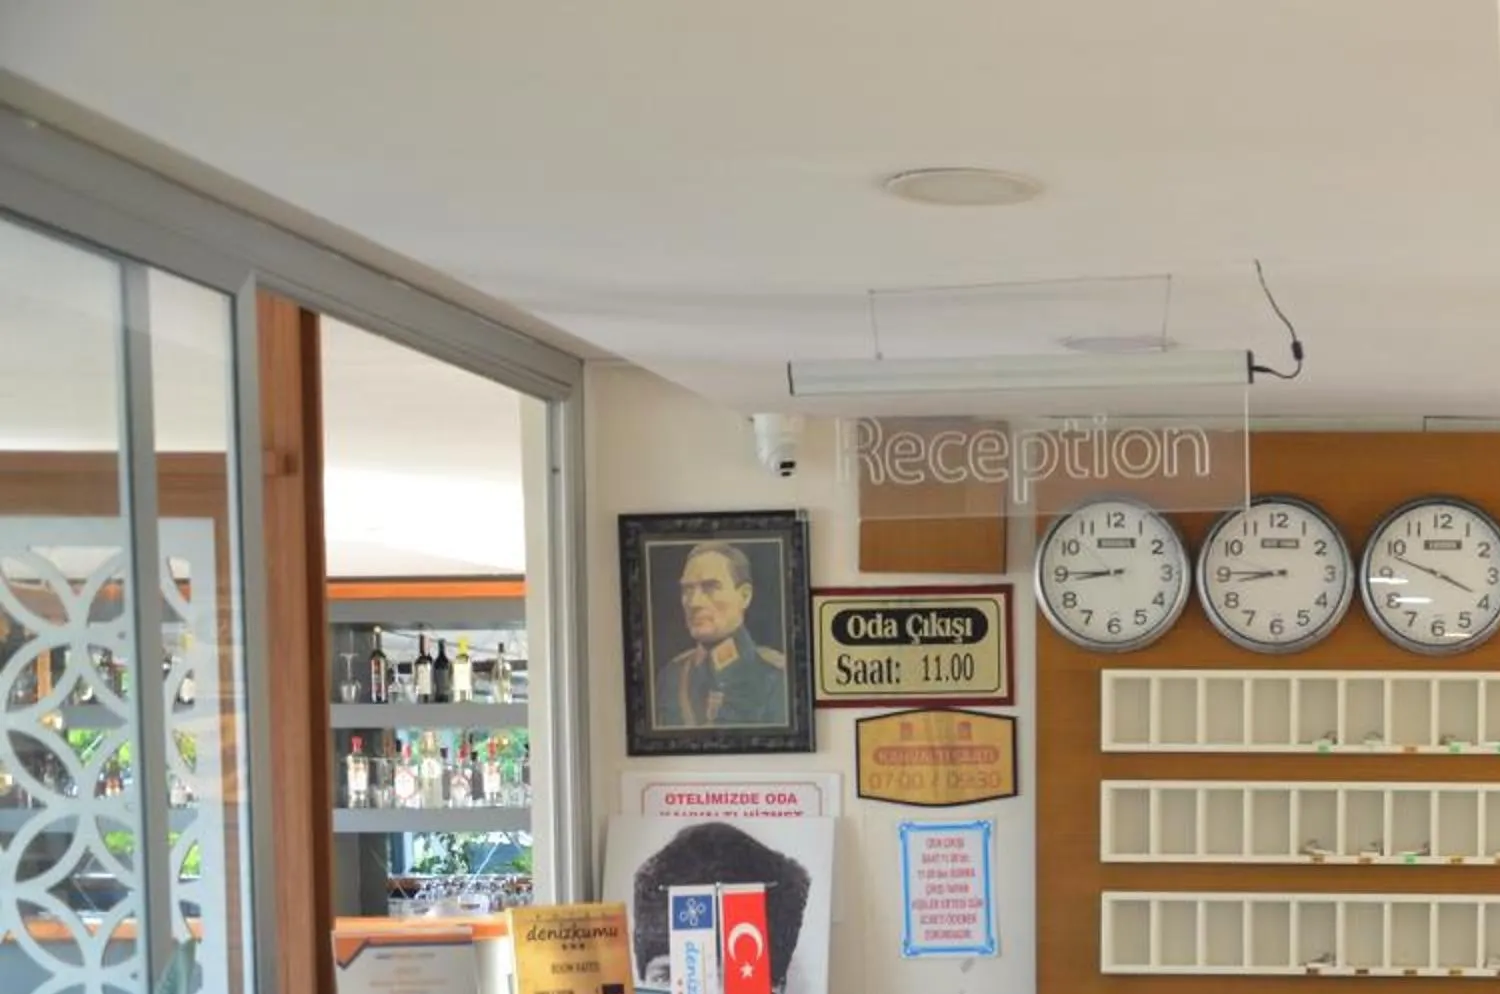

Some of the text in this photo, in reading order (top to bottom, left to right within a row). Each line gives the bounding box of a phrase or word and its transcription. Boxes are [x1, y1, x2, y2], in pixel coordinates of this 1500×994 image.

[835, 414, 1210, 504] Reception
[1106, 512, 1125, 528] 12
[1139, 520, 1143, 535] 1
[1269, 513, 1289, 528] 12
[1302, 521, 1306, 535] 1
[1433, 514, 1452, 529] 12
[1080, 521, 1094, 536] 11
[1244, 521, 1258, 536] 11
[1407, 521, 1421, 537] 11
[1465, 522, 1470, 537] 1
[1061, 540, 1080, 555] 10
[1151, 539, 1164, 554] 2
[1224, 540, 1243, 555] 10
[1314, 540, 1327, 555] 2
[1387, 540, 1406, 556] 10
[1478, 542, 1490, 558] 2
[1054, 567, 1067, 582] 9
[1161, 565, 1173, 581] 3
[1217, 567, 1230, 582] 9
[1324, 565, 1336, 582] 3
[1379, 565, 1393, 579] 9
[1487, 567, 1499, 584] 3
[1062, 592, 1076, 608] 8
[1152, 592, 1165, 606] 4
[1225, 592, 1239, 608] 8
[1314, 592, 1328, 607] 4
[1386, 592, 1400, 609] 8
[1477, 594, 1490, 610] 4
[1080, 609, 1093, 625] 7
[1135, 609, 1147, 625] 5
[1242, 610, 1255, 626] 7
[1297, 610, 1310, 626] 5
[1404, 612, 1416, 627] 7
[1458, 612, 1471, 628] 5
[847, 612, 973, 644] Oda Çıkışı
[1108, 618, 1121, 634] 6
[1270, 619, 1283, 635] 6
[1432, 621, 1445, 636] 6
[836, 653, 974, 685] Saat: 11.00
[665, 792, 797, 805] OTELİMİZDE ODA
[527, 923, 618, 942] denizkumu
